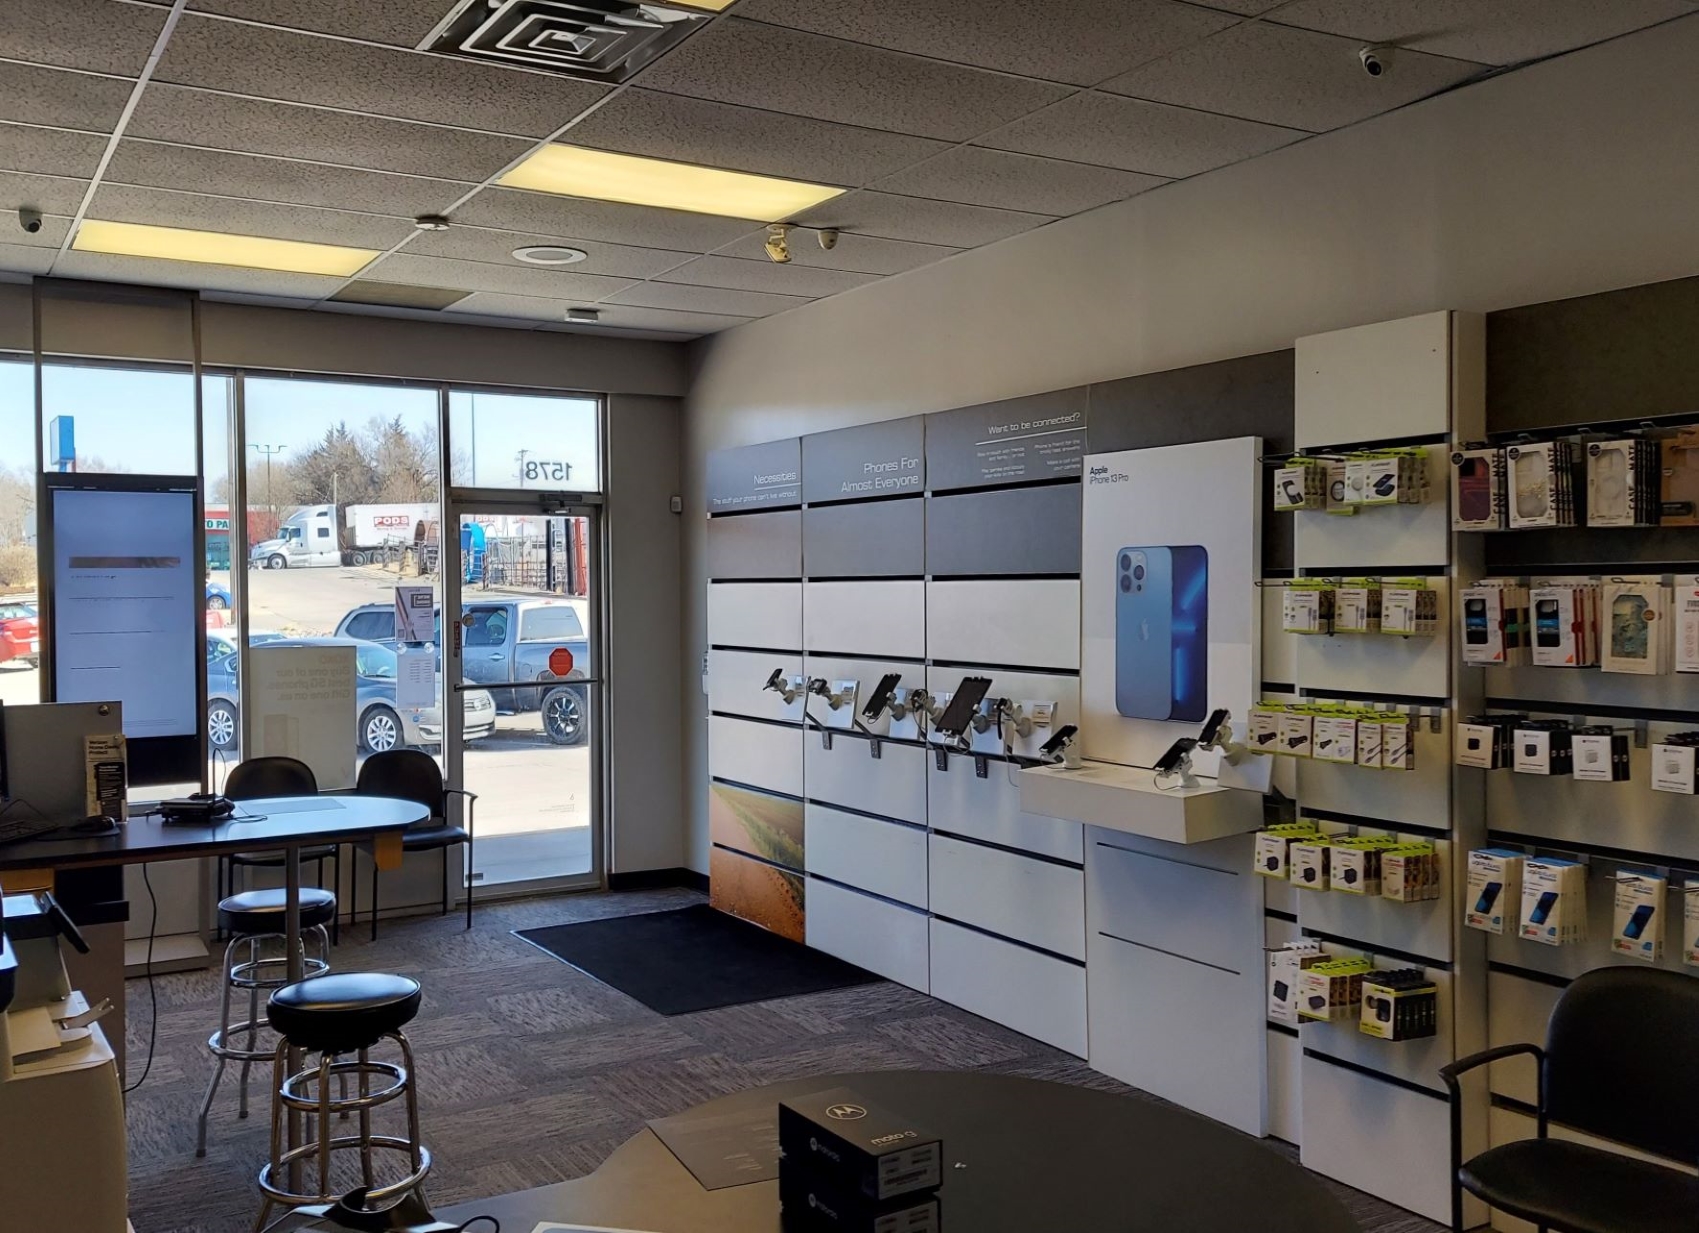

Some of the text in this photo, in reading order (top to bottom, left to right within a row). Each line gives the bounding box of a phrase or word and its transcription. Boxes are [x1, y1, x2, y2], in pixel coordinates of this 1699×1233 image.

[988, 424, 1009, 434] Want
[1021, 421, 1030, 429] be
[1032, 412, 1080, 428] connected?
[864, 457, 919, 474] Phones For
[1090, 466, 1108, 475] Apple
[753, 472, 797, 484] Necessities
[841, 475, 919, 492] Almost Everyone
[1090, 473, 1128, 484] iPhone 13 Pro
[374, 516, 409, 525] PODS
[871, 1134, 904, 1145] moto
